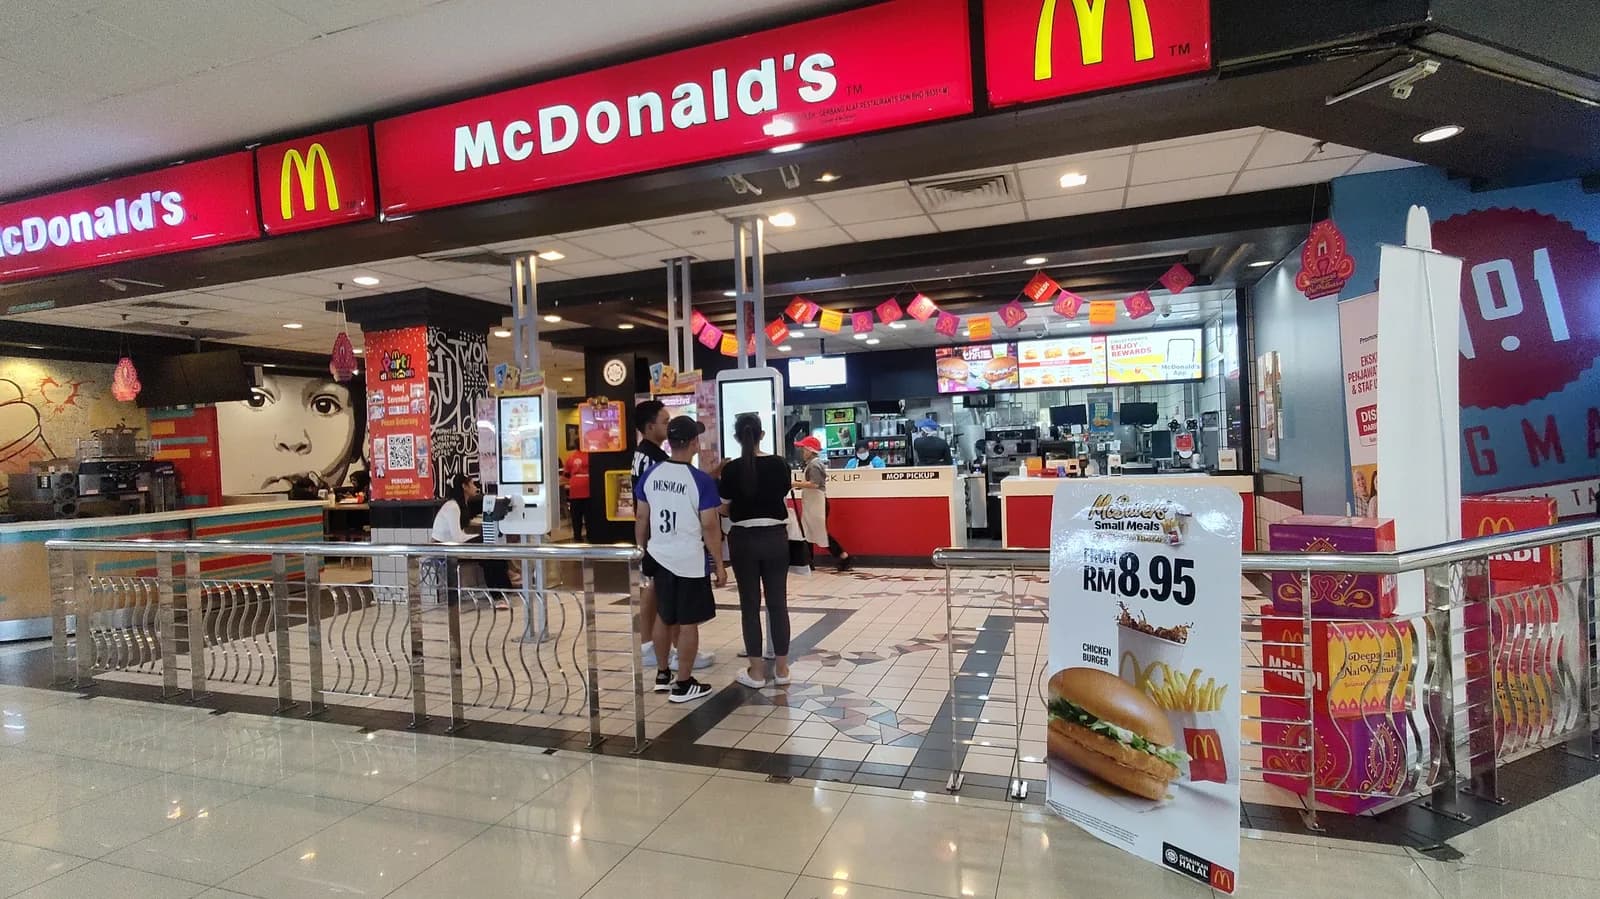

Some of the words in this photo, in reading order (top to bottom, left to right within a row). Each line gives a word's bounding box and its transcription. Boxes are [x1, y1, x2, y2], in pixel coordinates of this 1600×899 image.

[1169, 43, 1190, 56] TM
[453, 52, 838, 172] McDonald's
[0, 190, 184, 257] cDonald's
[1111, 342, 1138, 350] ENJOY
[1111, 347, 1152, 357] REWARDS
[1358, 380, 1373, 393] STAF
[844, 474, 860, 482] UP
[906, 472, 935, 480] PICKUP
[1095, 520, 1125, 531] Small
[1127, 521, 1160, 531] Meals
[1082, 643, 1112, 656] CHICKEN
[1082, 653, 1109, 667] BURGER
[1179, 859, 1208, 879] HALAL
